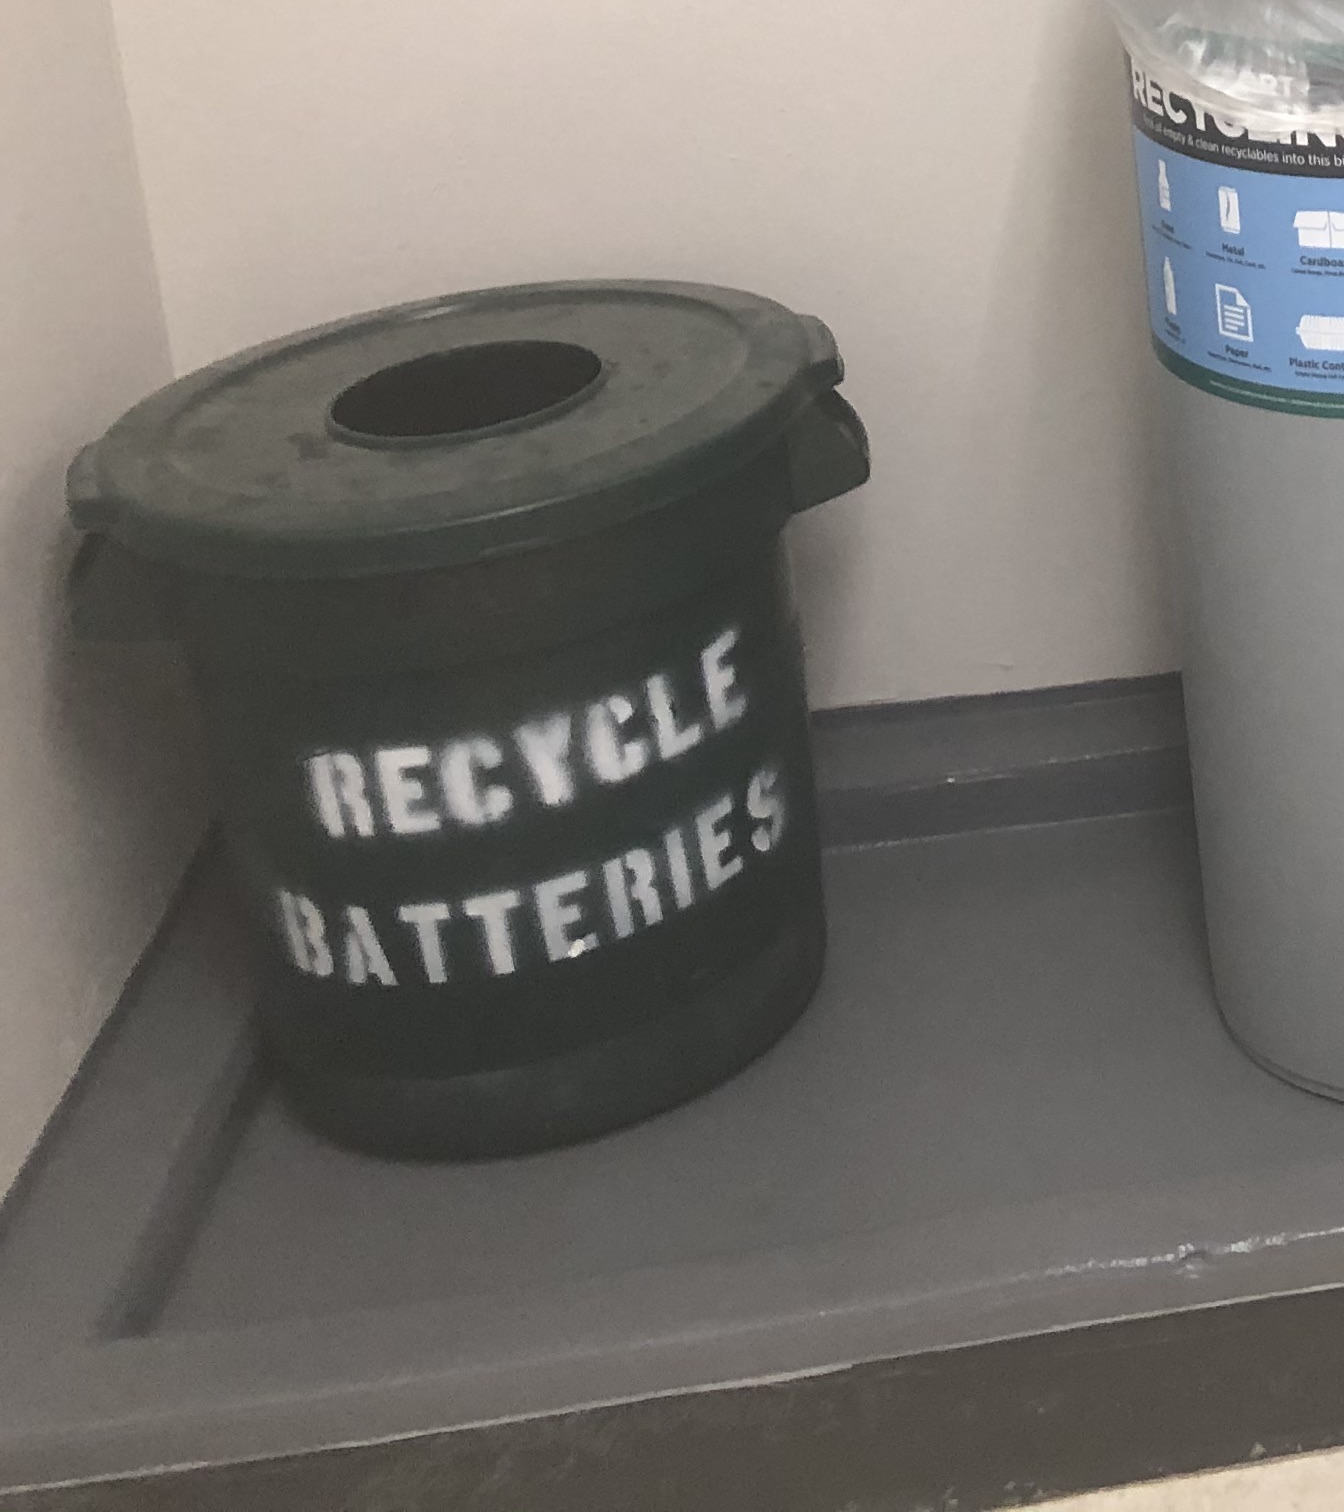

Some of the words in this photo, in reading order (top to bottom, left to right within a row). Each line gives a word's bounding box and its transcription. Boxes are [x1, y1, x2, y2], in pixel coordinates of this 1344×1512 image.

[1221, 144, 1279, 163] recyclables
[1282, 152, 1305, 165] into
[1308, 154, 1331, 167] this
[1289, 358, 1319, 369] Plastic
[305, 627, 748, 839] RECYCLE
[280, 767, 787, 987] BATTERIES
